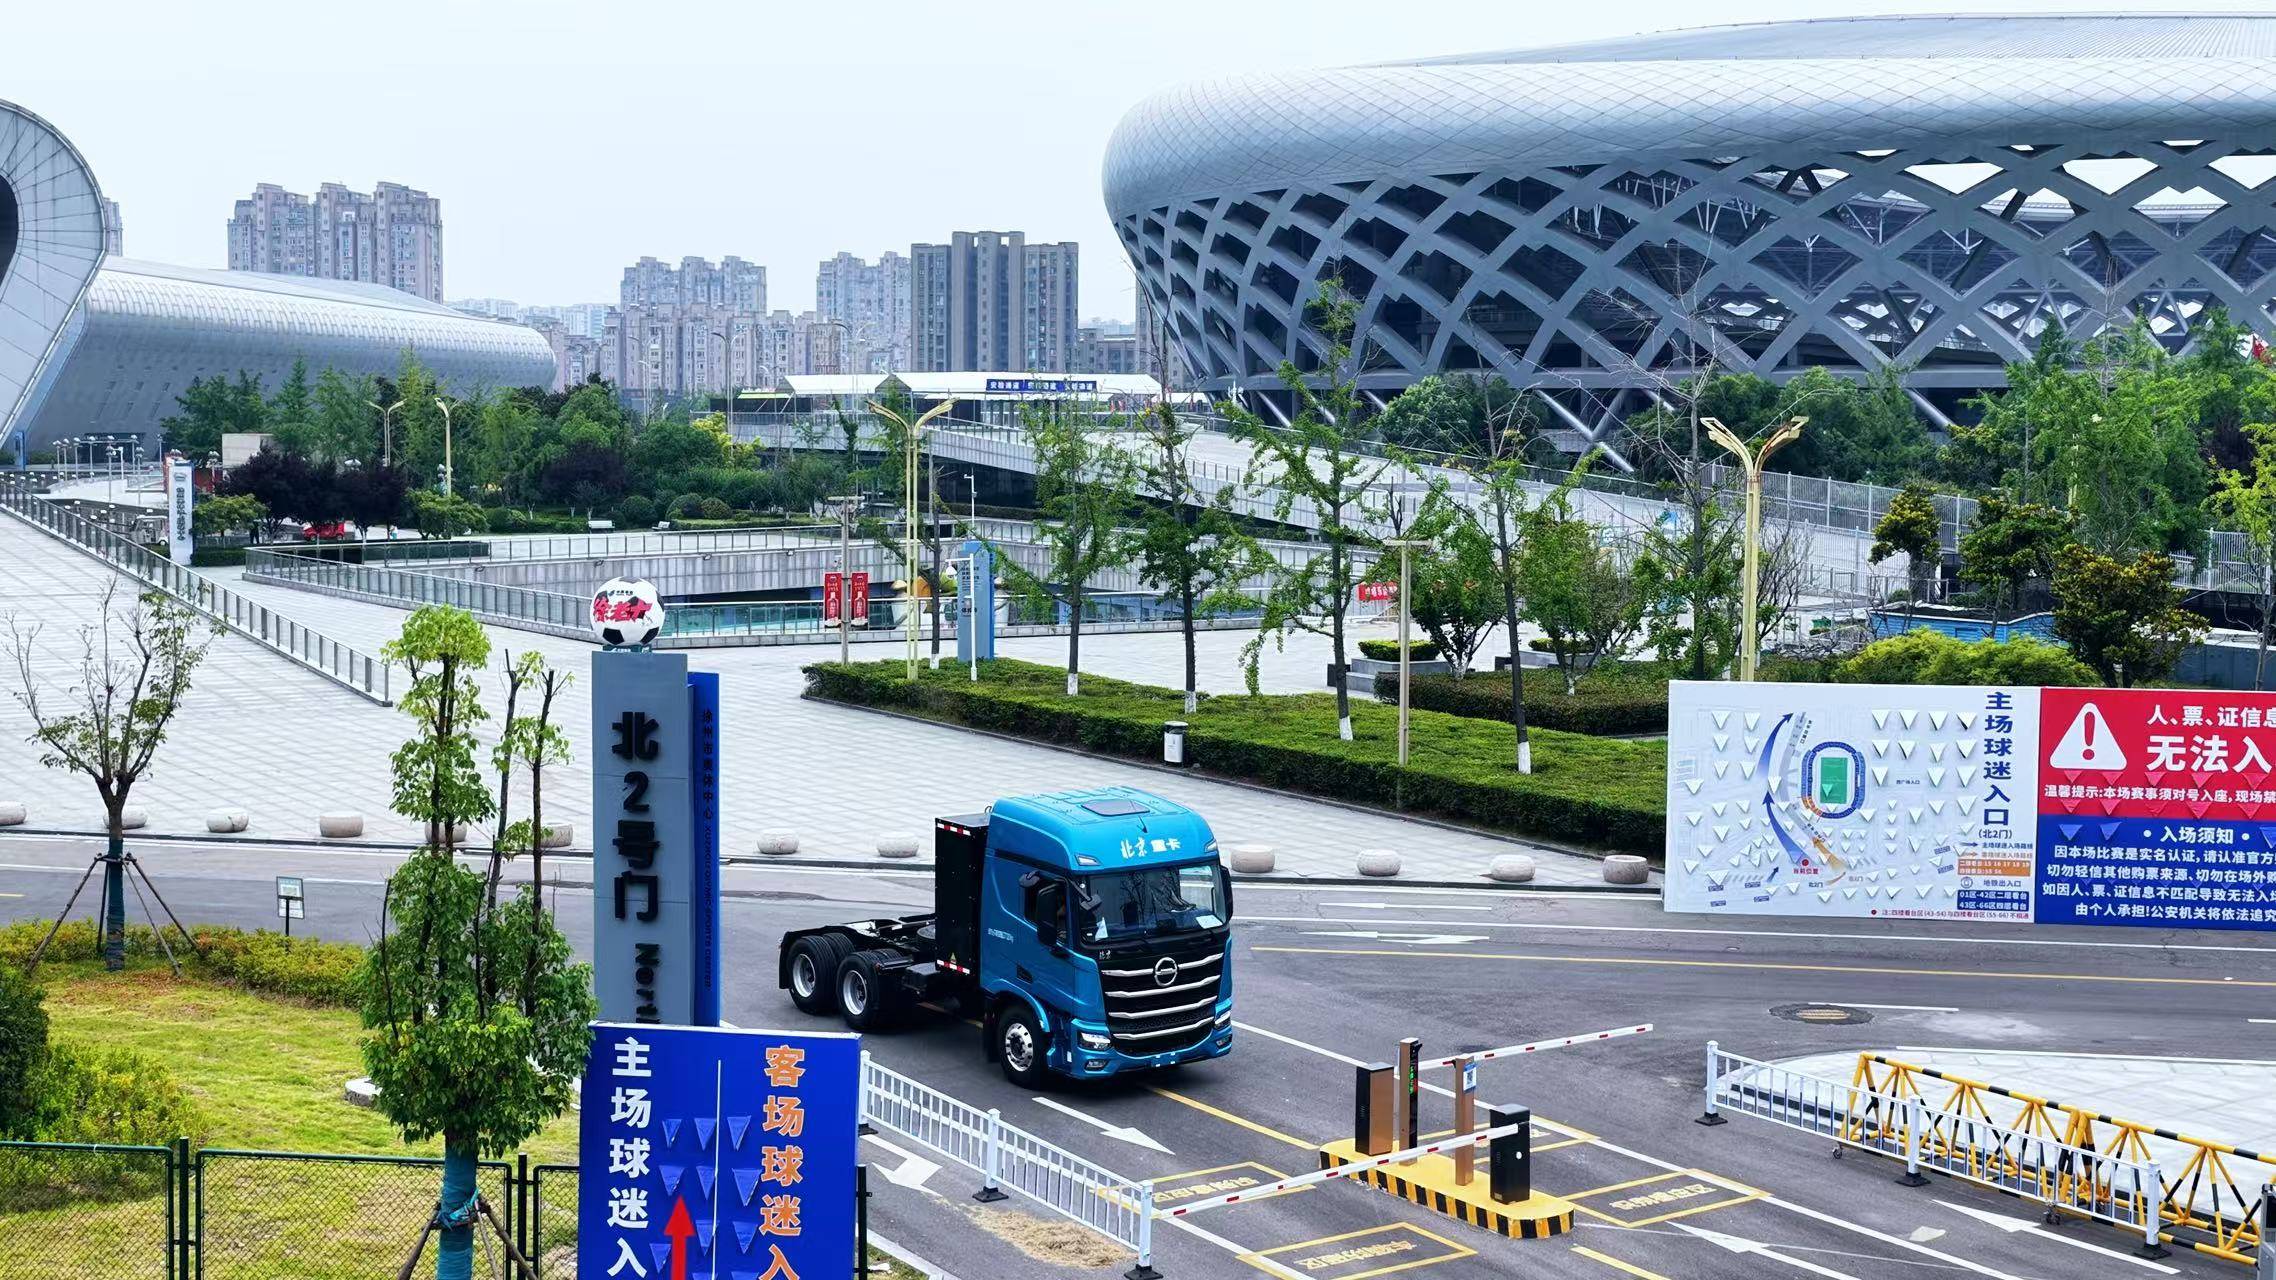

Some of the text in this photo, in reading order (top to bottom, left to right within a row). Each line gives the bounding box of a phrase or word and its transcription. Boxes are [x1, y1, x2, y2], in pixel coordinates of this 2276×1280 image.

[1983, 691, 2013, 826] 主场球迷入口
[2147, 734, 2273, 774] 无法入
[612, 711, 660, 923] 北2号门
[2054, 845, 2276, 865] 因本场比赛是实名认证,请认准官方
[2160, 826, 2234, 845] 入场须知
[635, 943, 660, 1024] Nort
[606, 1036, 652, 1279] 主场球迷入
[758, 1044, 806, 1280] 客场球迷入
